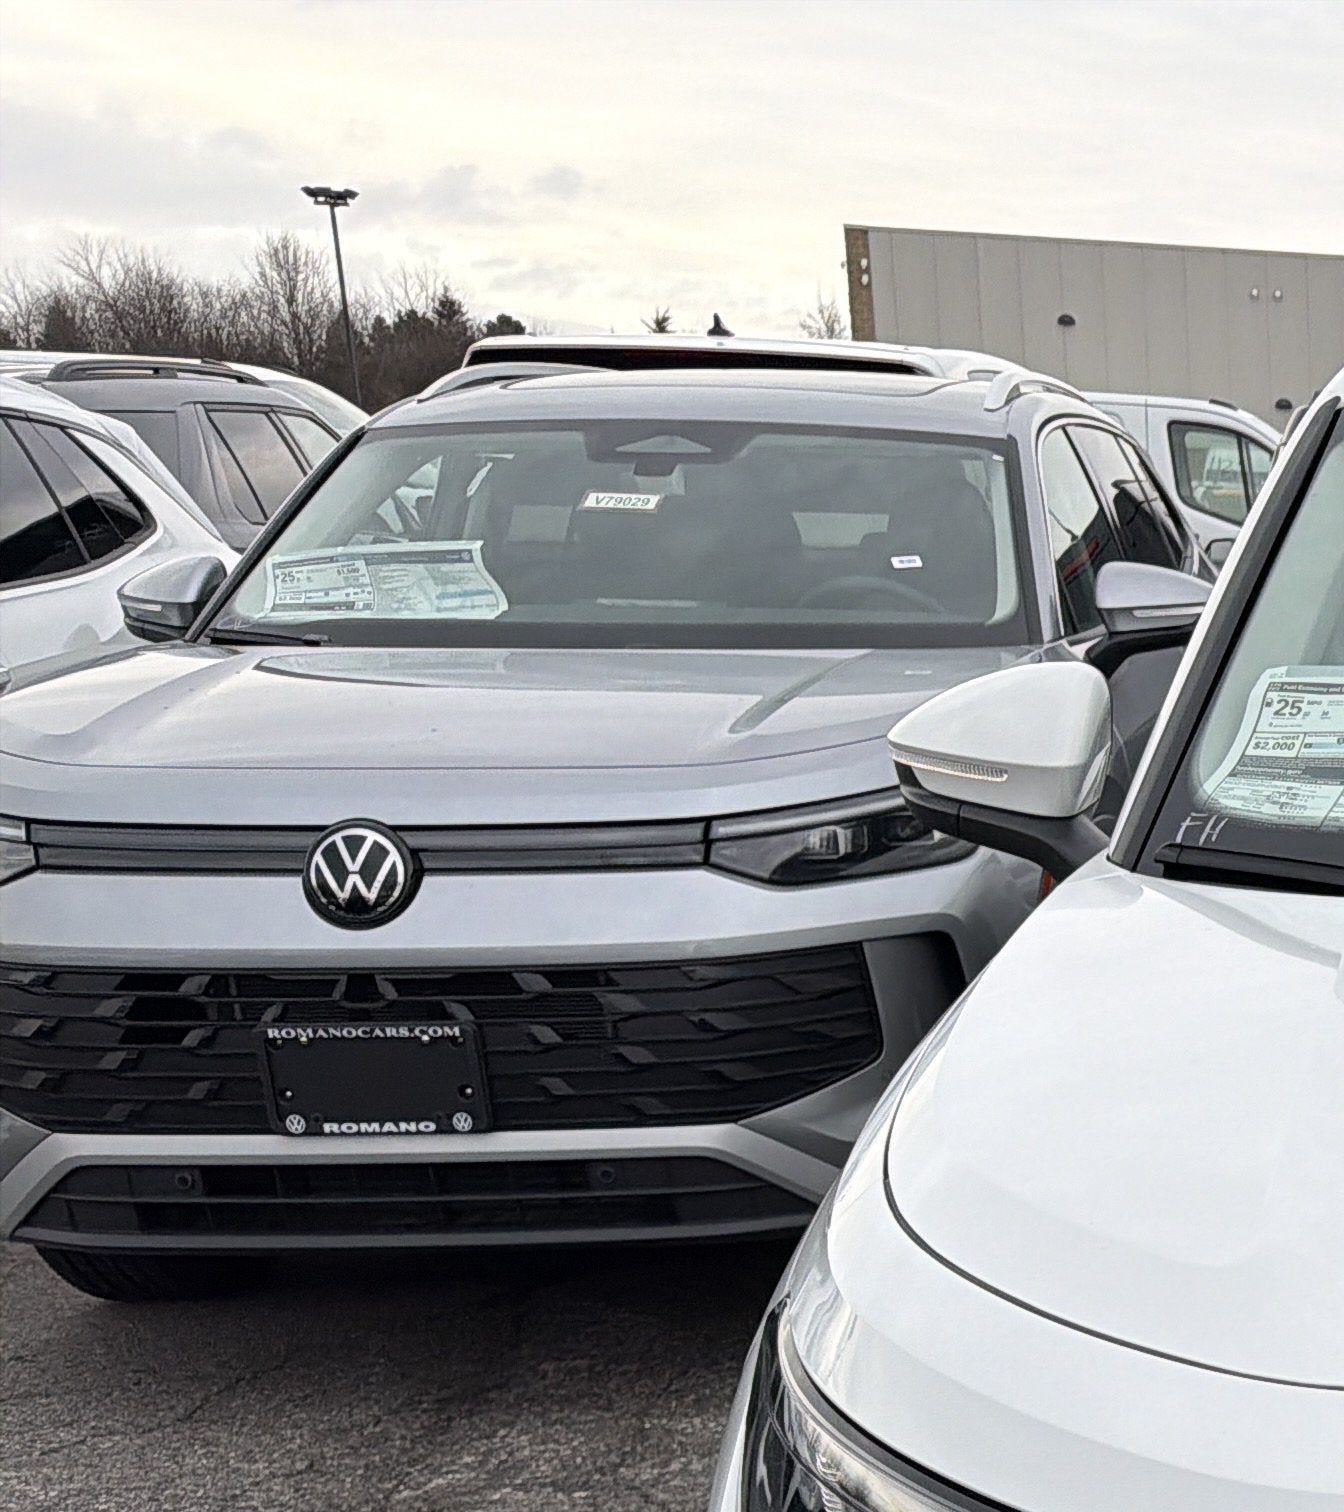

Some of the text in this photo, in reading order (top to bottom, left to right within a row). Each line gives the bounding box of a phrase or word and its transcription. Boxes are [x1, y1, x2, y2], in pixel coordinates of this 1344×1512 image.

[594, 495, 651, 507] V79029
[280, 571, 296, 583] 25
[1273, 699, 1304, 717] 25
[1252, 741, 1296, 751] $2,000
[267, 1026, 462, 1040] ROMANOCARS.COM
[323, 1120, 437, 1134] ROMANO
